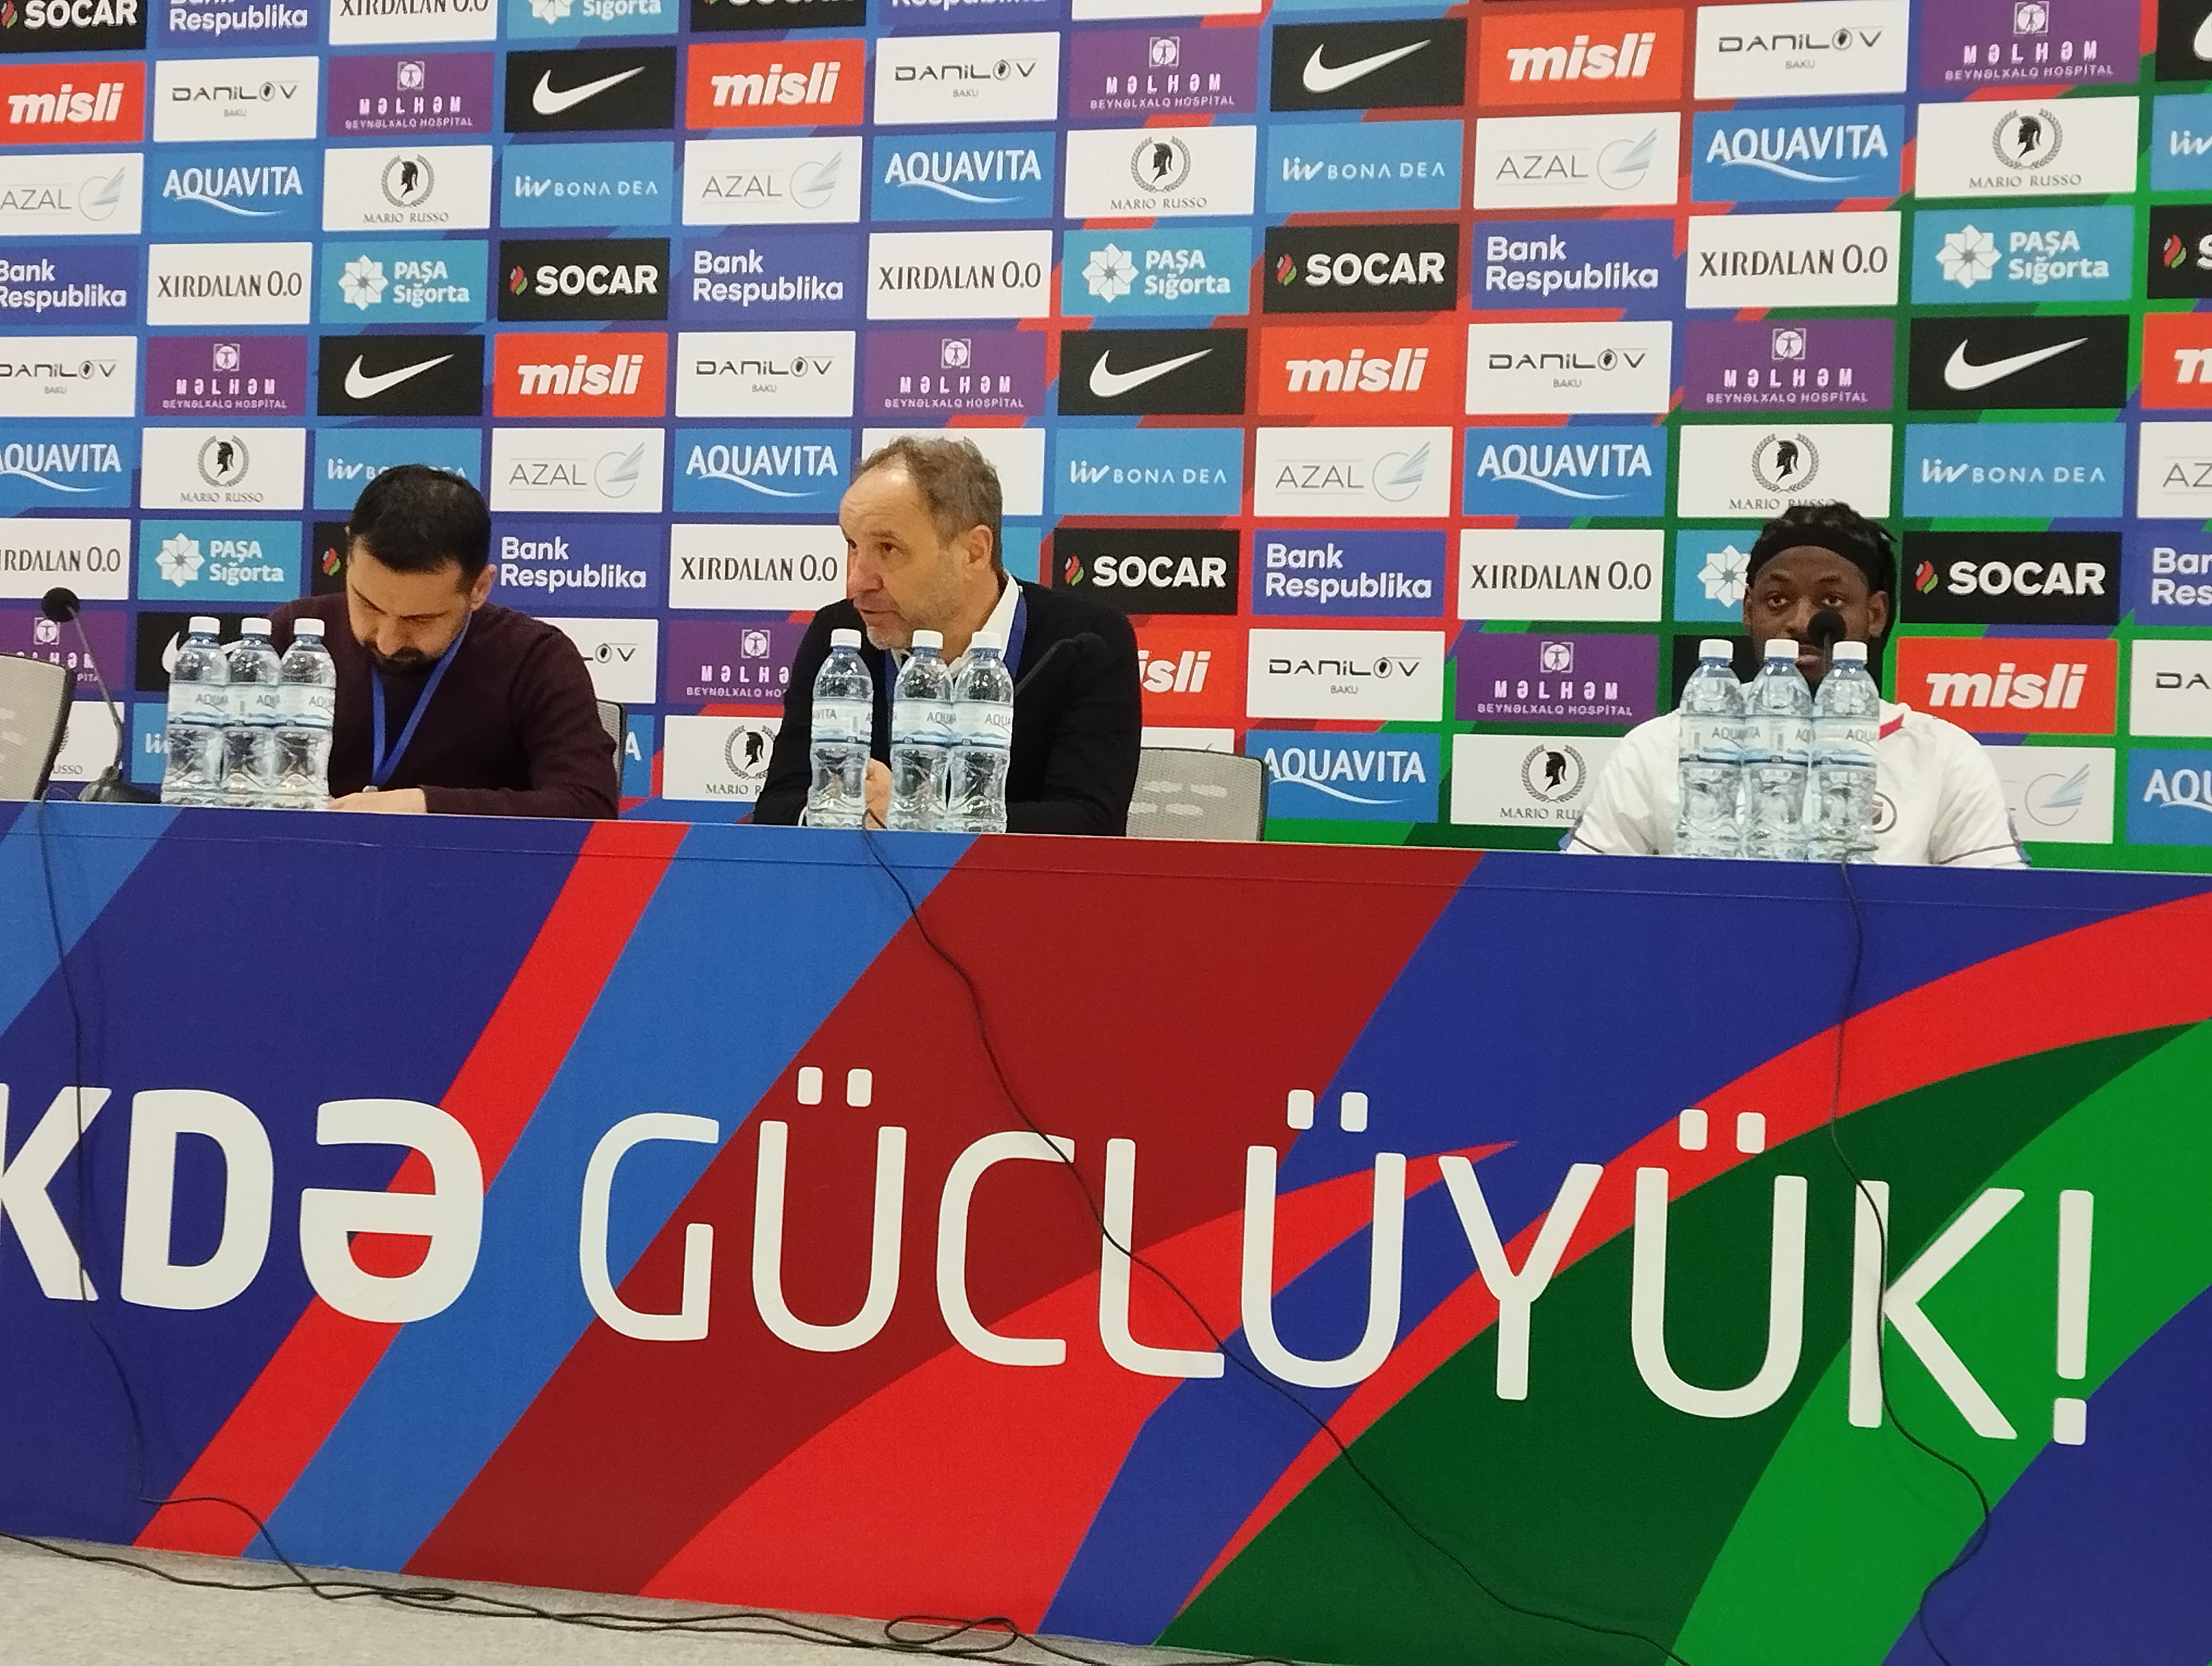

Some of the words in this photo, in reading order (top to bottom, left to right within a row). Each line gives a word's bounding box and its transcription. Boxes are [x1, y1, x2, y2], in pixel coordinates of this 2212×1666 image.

[24, 0, 137, 28] SOCAR
[170, 5, 307, 36] Respublika
[1507, 33, 1656, 81] misli
[1785, 60, 1815, 69] BAKU
[711, 62, 840, 106] misli
[953, 89, 979, 97] BAKU
[8, 82, 124, 123] misli
[1706, 125, 1888, 164] AQUAVITA
[885, 150, 1041, 183] AQUAVITA
[1328, 163, 1391, 180] BONA
[1400, 162, 1445, 178] DEA
[1496, 156, 1588, 180] AZAL
[163, 166, 303, 198] AQUAVITA
[555, 182, 610, 197] BONA
[618, 181, 658, 196] DEA
[703, 175, 782, 198] AZAL
[1969, 176, 2022, 188] MARIO
[2030, 174, 2081, 186] RUSSO
[0, 189, 72, 210] AZAL
[1111, 198, 1156, 209] MARIO
[1163, 198, 1207, 208] RUSSO
[364, 213, 403, 223] MARIO
[410, 213, 448, 222] RUSSO
[1487, 234, 1566, 261] Bank
[2010, 230, 2080, 257] PAŞA
[0, 260, 55, 281] Bank
[395, 261, 448, 286] PAŞA
[695, 249, 763, 274] Bank
[1146, 250, 1206, 274] PAŞA
[1306, 252, 1445, 285] SOCAR
[1700, 249, 1834, 276] XIRDALAN
[1843, 245, 1887, 273] 0.0
[158, 275, 261, 297] XIRDALAN
[268, 271, 301, 296] 0.0
[536, 265, 658, 295] SOCAR
[879, 266, 994, 290] XIRDALAN
[1002, 261, 1040, 287] 0.0
[1486, 262, 1658, 297] Respublika
[0, 285, 126, 313] Respublika
[693, 275, 843, 307] Respublika
[518, 355, 644, 395] misli
[1285, 348, 1429, 392] misli
[1553, 379, 1581, 387] BAKU
[752, 385, 776, 393] BAKU
[686, 446, 838, 477] AQUAVITA
[1478, 445, 1651, 477] AQUAVITA
[510, 465, 587, 486] AZAL
[1114, 469, 1175, 483] BONA
[1183, 469, 1226, 484] DEA
[1275, 466, 1364, 489] AZAL
[1972, 467, 2044, 483] BONA
[2054, 467, 2105, 482] DEA
[2163, 463, 2212, 488] AZ
[181, 492, 220, 502] MARIO
[226, 492, 263, 503] RUSSO
[1729, 499, 1780, 509] MARIO
[0, 550, 81, 572] RDALAN
[87, 547, 120, 572] 0.0
[210, 541, 262, 563] PAŞA
[501, 536, 569, 560] Bank
[1267, 543, 1343, 568] Bank
[2152, 548, 2212, 574] Ban
[501, 563, 646, 593] Respublika
[681, 558, 793, 581] XIRDALAN
[800, 555, 837, 581] 0.0
[1092, 556, 1226, 587] SOCAR
[1471, 565, 1599, 589] XIRDALAN
[1608, 561, 1651, 589] 0.0
[1947, 561, 2105, 595] SOCAR
[1266, 572, 1431, 604] Respublika
[701, 665, 789, 683] MƏLHƏ
[1138, 650, 1211, 692] isli
[1331, 685, 1358, 694] BAKU
[1926, 663, 2087, 708] misli
[1264, 747, 1426, 783] AQUAVITA
[706, 784, 748, 794] MARIO
[1500, 808, 1548, 819] MARIO
[579, 1067, 2094, 1445] GÜCLÜYÜK!
